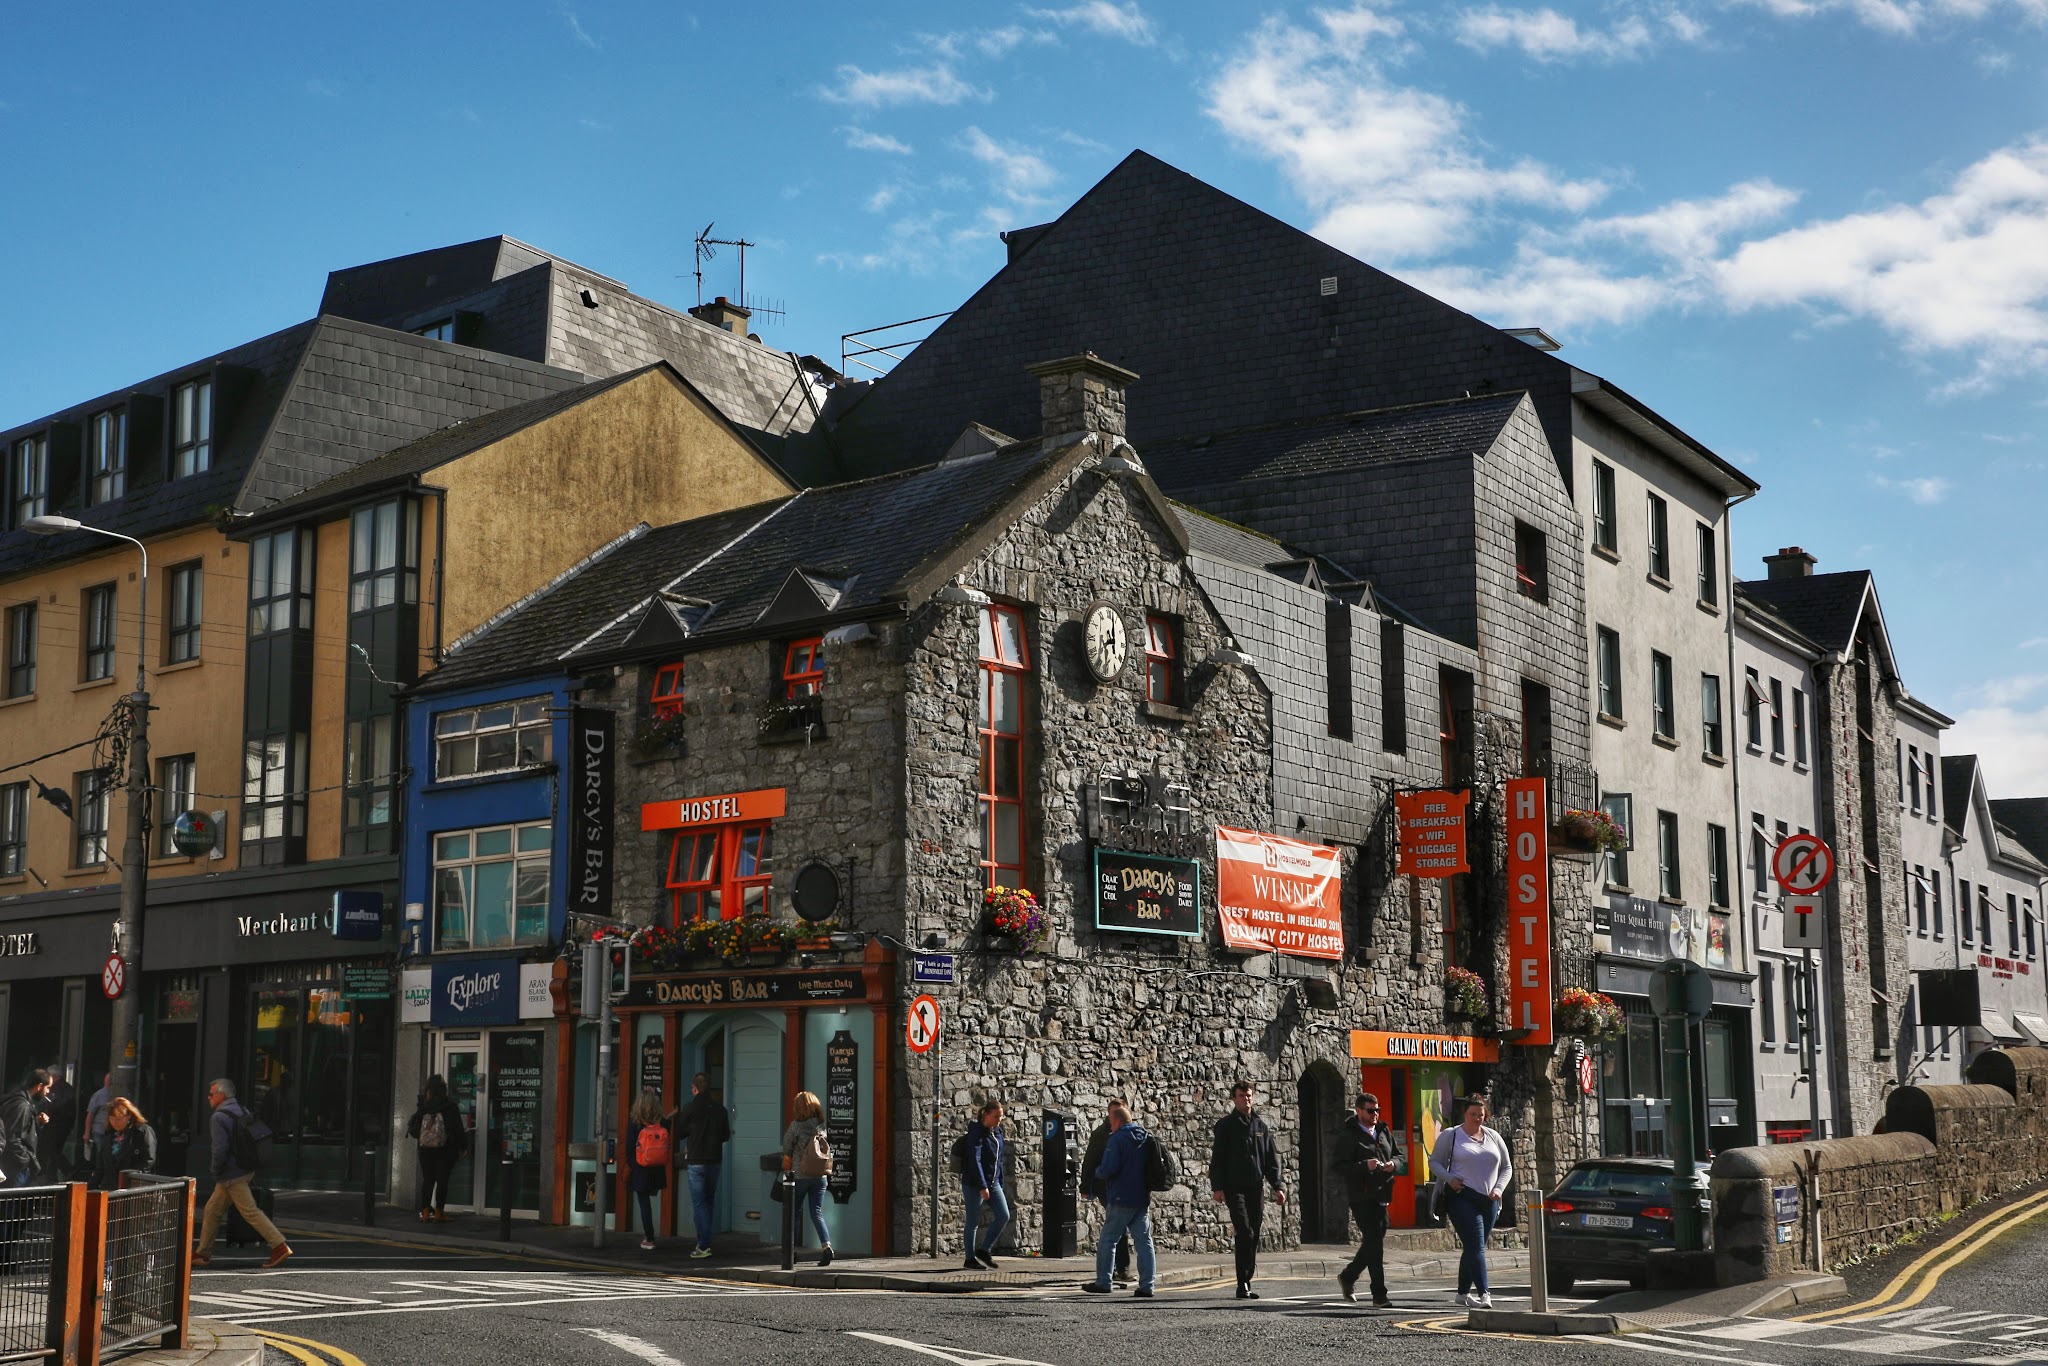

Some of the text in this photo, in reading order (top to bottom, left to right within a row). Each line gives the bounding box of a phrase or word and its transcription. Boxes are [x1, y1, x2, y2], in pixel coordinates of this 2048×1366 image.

[680, 798, 740, 822] HOSTEL
[1424, 804, 1446, 813] FREE
[1410, 816, 1462, 828] BREAKFAST
[1426, 831, 1446, 840] WIFI
[1416, 844, 1456, 854] LUGGAGE
[1416, 858, 1457, 868] STORAGE
[1178, 882, 1192, 892] FOOD
[1252, 874, 1326, 908] WINNER
[1178, 898, 1193, 908] DAILY
[1516, 790, 1540, 1031] HOSTEL
[1225, 906, 1250, 918] BEST
[1252, 909, 1284, 924] HOSTEL
[1288, 914, 1296, 924] IN
[1298, 915, 1327, 929] IRELAND
[1614, 912, 1665, 930] EYRE SQUARE HOTEL
[238, 912, 317, 936] Merchant
[1228, 923, 1343, 952] GALWAY CITY HOSTEL
[528, 980, 546, 988] ARAN
[405, 989, 432, 1000] LALLY
[447, 972, 500, 1012] Explore
[1388, 1038, 1470, 1058] GALWAY CITY HOSTEL
[502, 1090, 536, 1098] CONNEMARA
[1046, 1125, 1054, 1136] P
[1588, 1216, 1630, 1227] 171-D-39305
